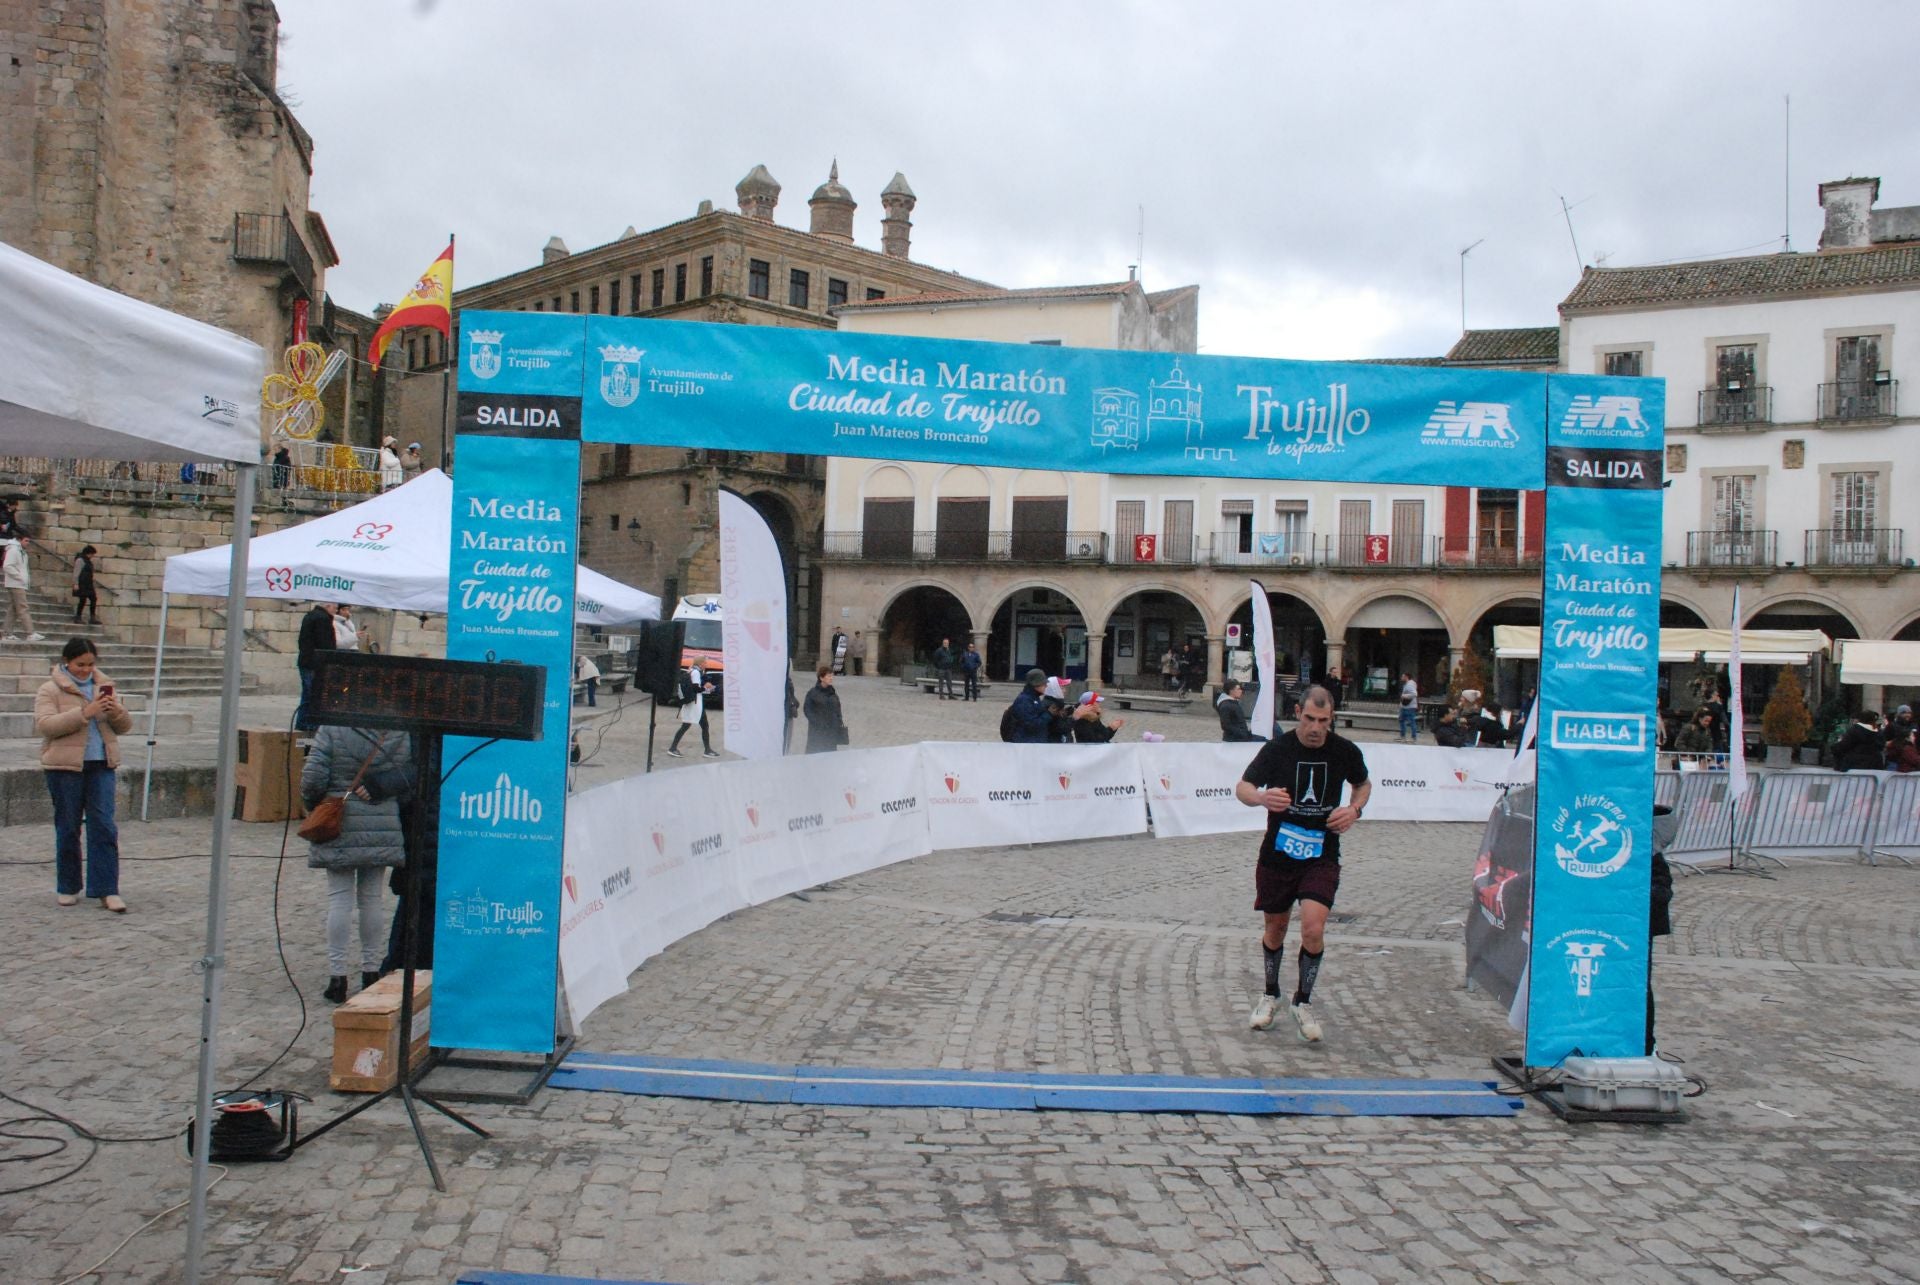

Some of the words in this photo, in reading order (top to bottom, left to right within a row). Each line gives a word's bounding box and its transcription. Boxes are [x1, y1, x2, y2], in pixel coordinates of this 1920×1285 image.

[507, 357, 551, 370] Trujillo
[649, 367, 719, 382] Ayuntamiento
[720, 372, 734, 381] de
[826, 354, 926, 387] Media
[936, 362, 1067, 395] Maratón
[648, 379, 704, 398] Trujillo
[476, 405, 561, 429] SALIDA
[789, 382, 893, 416] Ciudad
[896, 393, 935, 418] de
[941, 393, 1042, 434] Trujillo
[1236, 382, 1371, 447] Trujillo
[833, 422, 866, 437] Juan
[870, 424, 920, 440] Mateos
[924, 428, 989, 445] Broncano
[1421, 437, 1516, 449] www.musicrun.es
[1560, 426, 1646, 439] www.musicrun.es
[1266, 435, 1282, 456] te
[1566, 458, 1645, 480] SALIDA
[468, 497, 562, 522] Media
[316, 538, 393, 553] primaflor
[460, 530, 568, 554] Maratón
[1560, 543, 1647, 565] Media
[473, 559, 529, 577] Ciudad
[530, 563, 552, 578] de
[293, 573, 356, 592] primaflor
[1554, 573, 1653, 595] Maratón
[459, 579, 563, 622] Trujillo
[1565, 601, 1615, 617] Ciudad
[1616, 604, 1637, 618] de
[462, 624, 482, 633] Juan
[483, 625, 515, 635] Mateos
[517, 626, 559, 637] Broncano
[1552, 619, 1648, 659] Trujillo
[1555, 661, 1574, 670] Juan
[1575, 661, 1606, 671] Mateos
[1607, 662, 1646, 673] Broncano
[1564, 722, 1631, 741] HABLA
[1552, 805, 1570, 832] Club
[1575, 793, 1627, 821] Atletismo
[1283, 837, 1314, 858] 536
[490, 901, 543, 925] Trujillo
